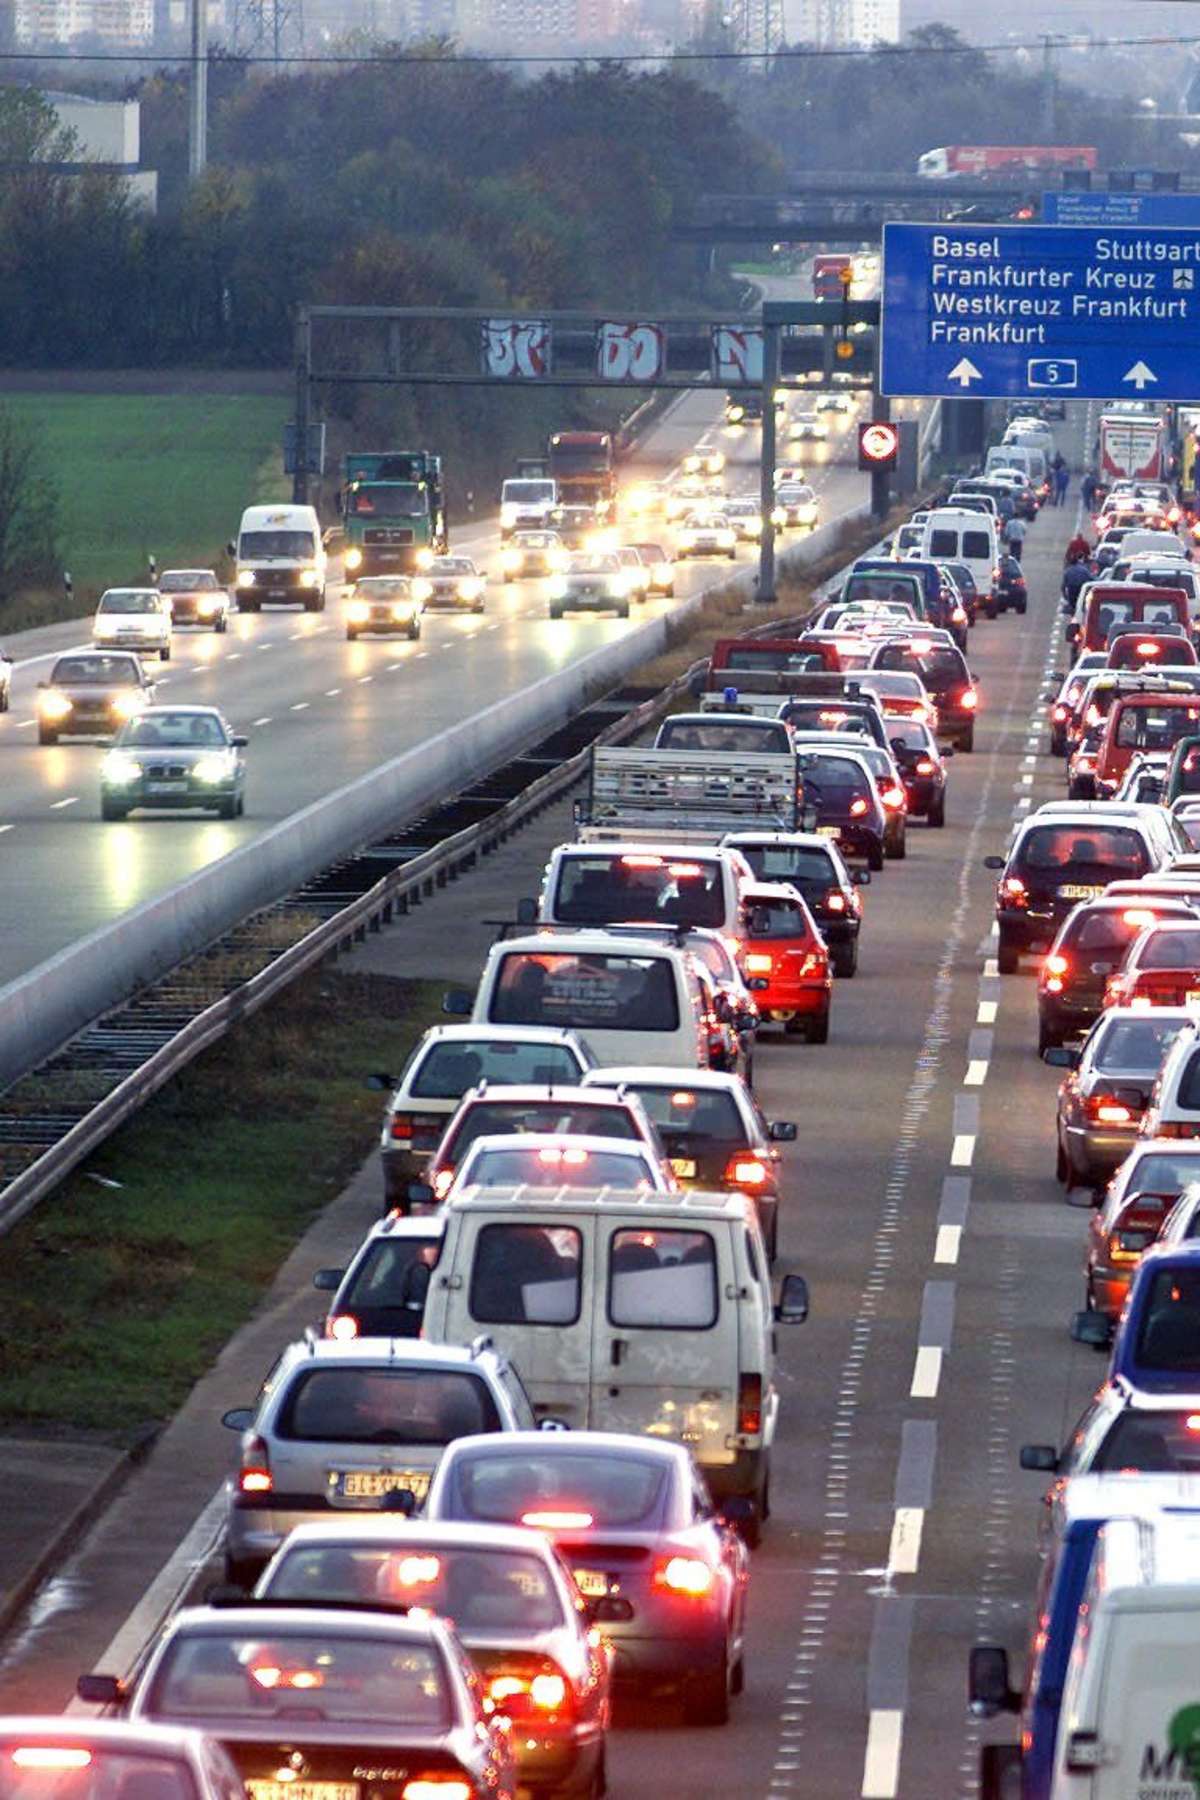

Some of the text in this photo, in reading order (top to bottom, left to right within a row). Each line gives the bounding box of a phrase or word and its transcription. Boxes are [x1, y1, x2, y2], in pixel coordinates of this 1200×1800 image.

[932, 236, 1000, 258] Basel
[932, 265, 1156, 289] Frankfurter Kreuz
[933, 293, 1187, 318] Westkreuz Frankfurt
[932, 322, 1046, 344] Frankfurt
[1046, 364, 1058, 383] 5
